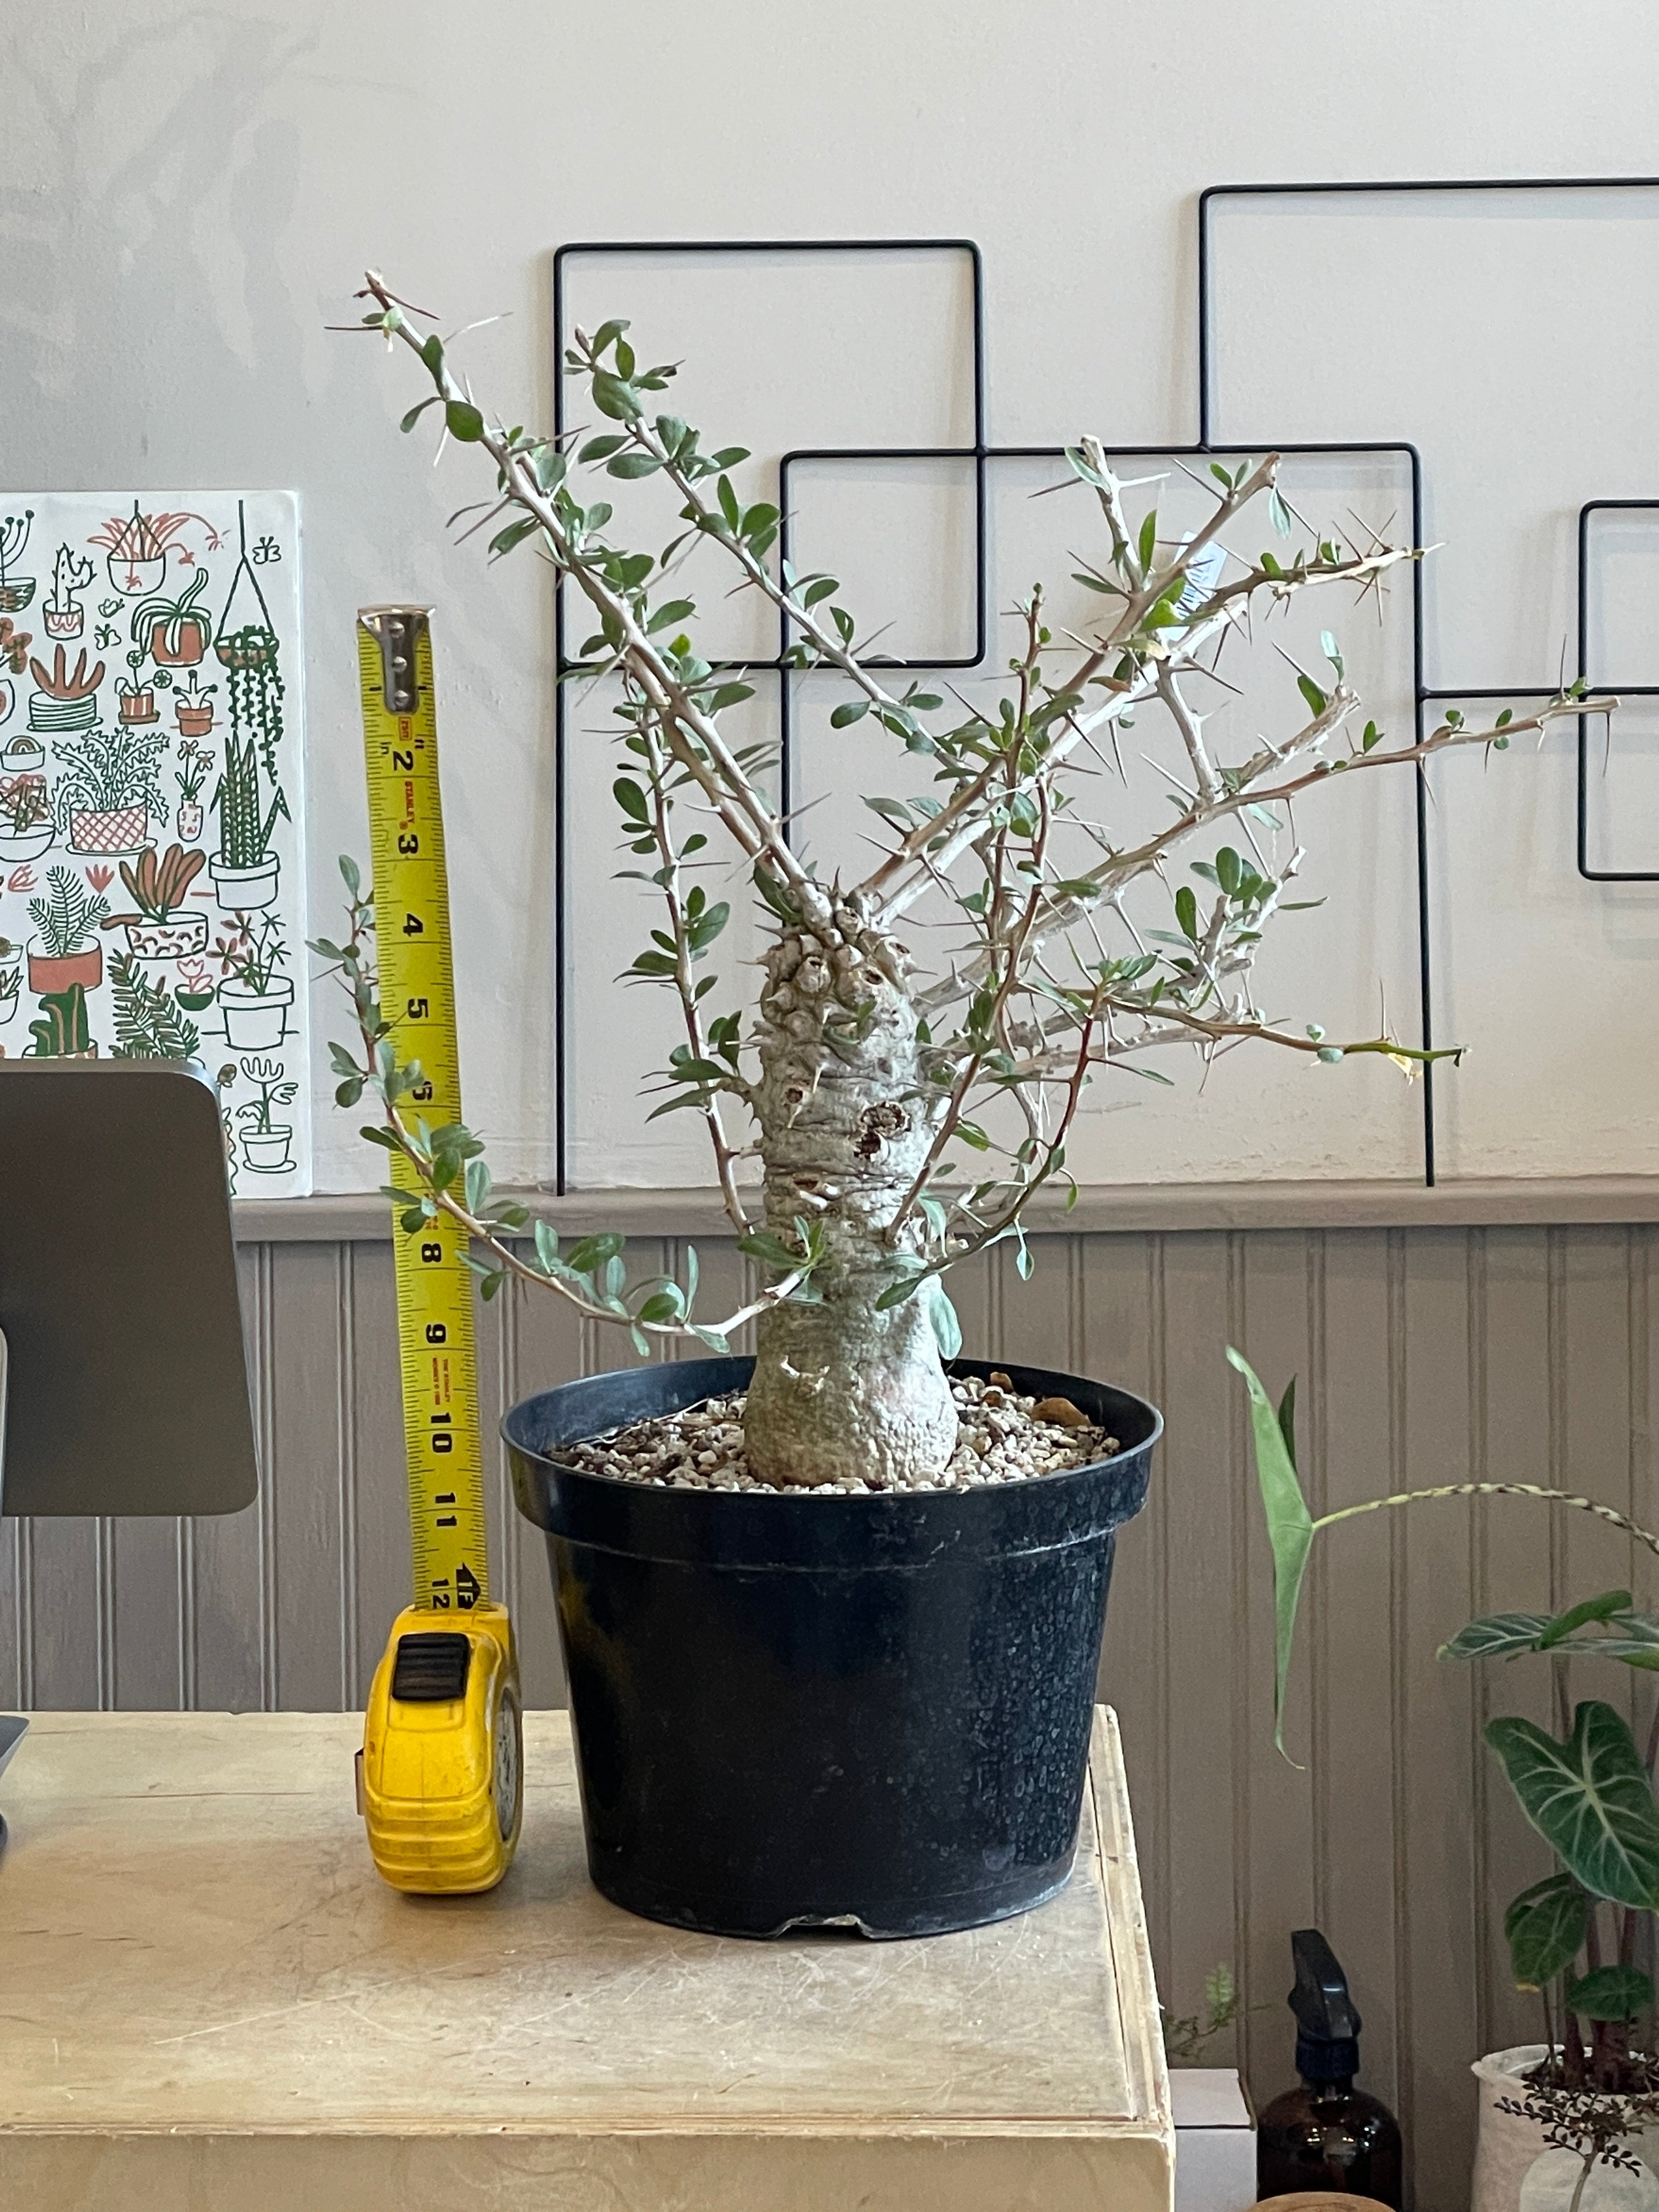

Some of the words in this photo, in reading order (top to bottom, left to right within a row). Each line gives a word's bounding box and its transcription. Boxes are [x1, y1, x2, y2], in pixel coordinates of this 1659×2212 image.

[393, 751, 414, 771] 2
[405, 781, 414, 824] STANLEY
[398, 834, 419, 854] 3
[403, 913, 423, 936] 4
[408, 999, 428, 1019] 5
[422, 1243, 442, 1263] 8
[426, 1324, 446, 1344] 9
[431, 1412, 452, 1453] 10
[435, 1492, 456, 1527] 11
[432, 1578, 450, 1609] 12
